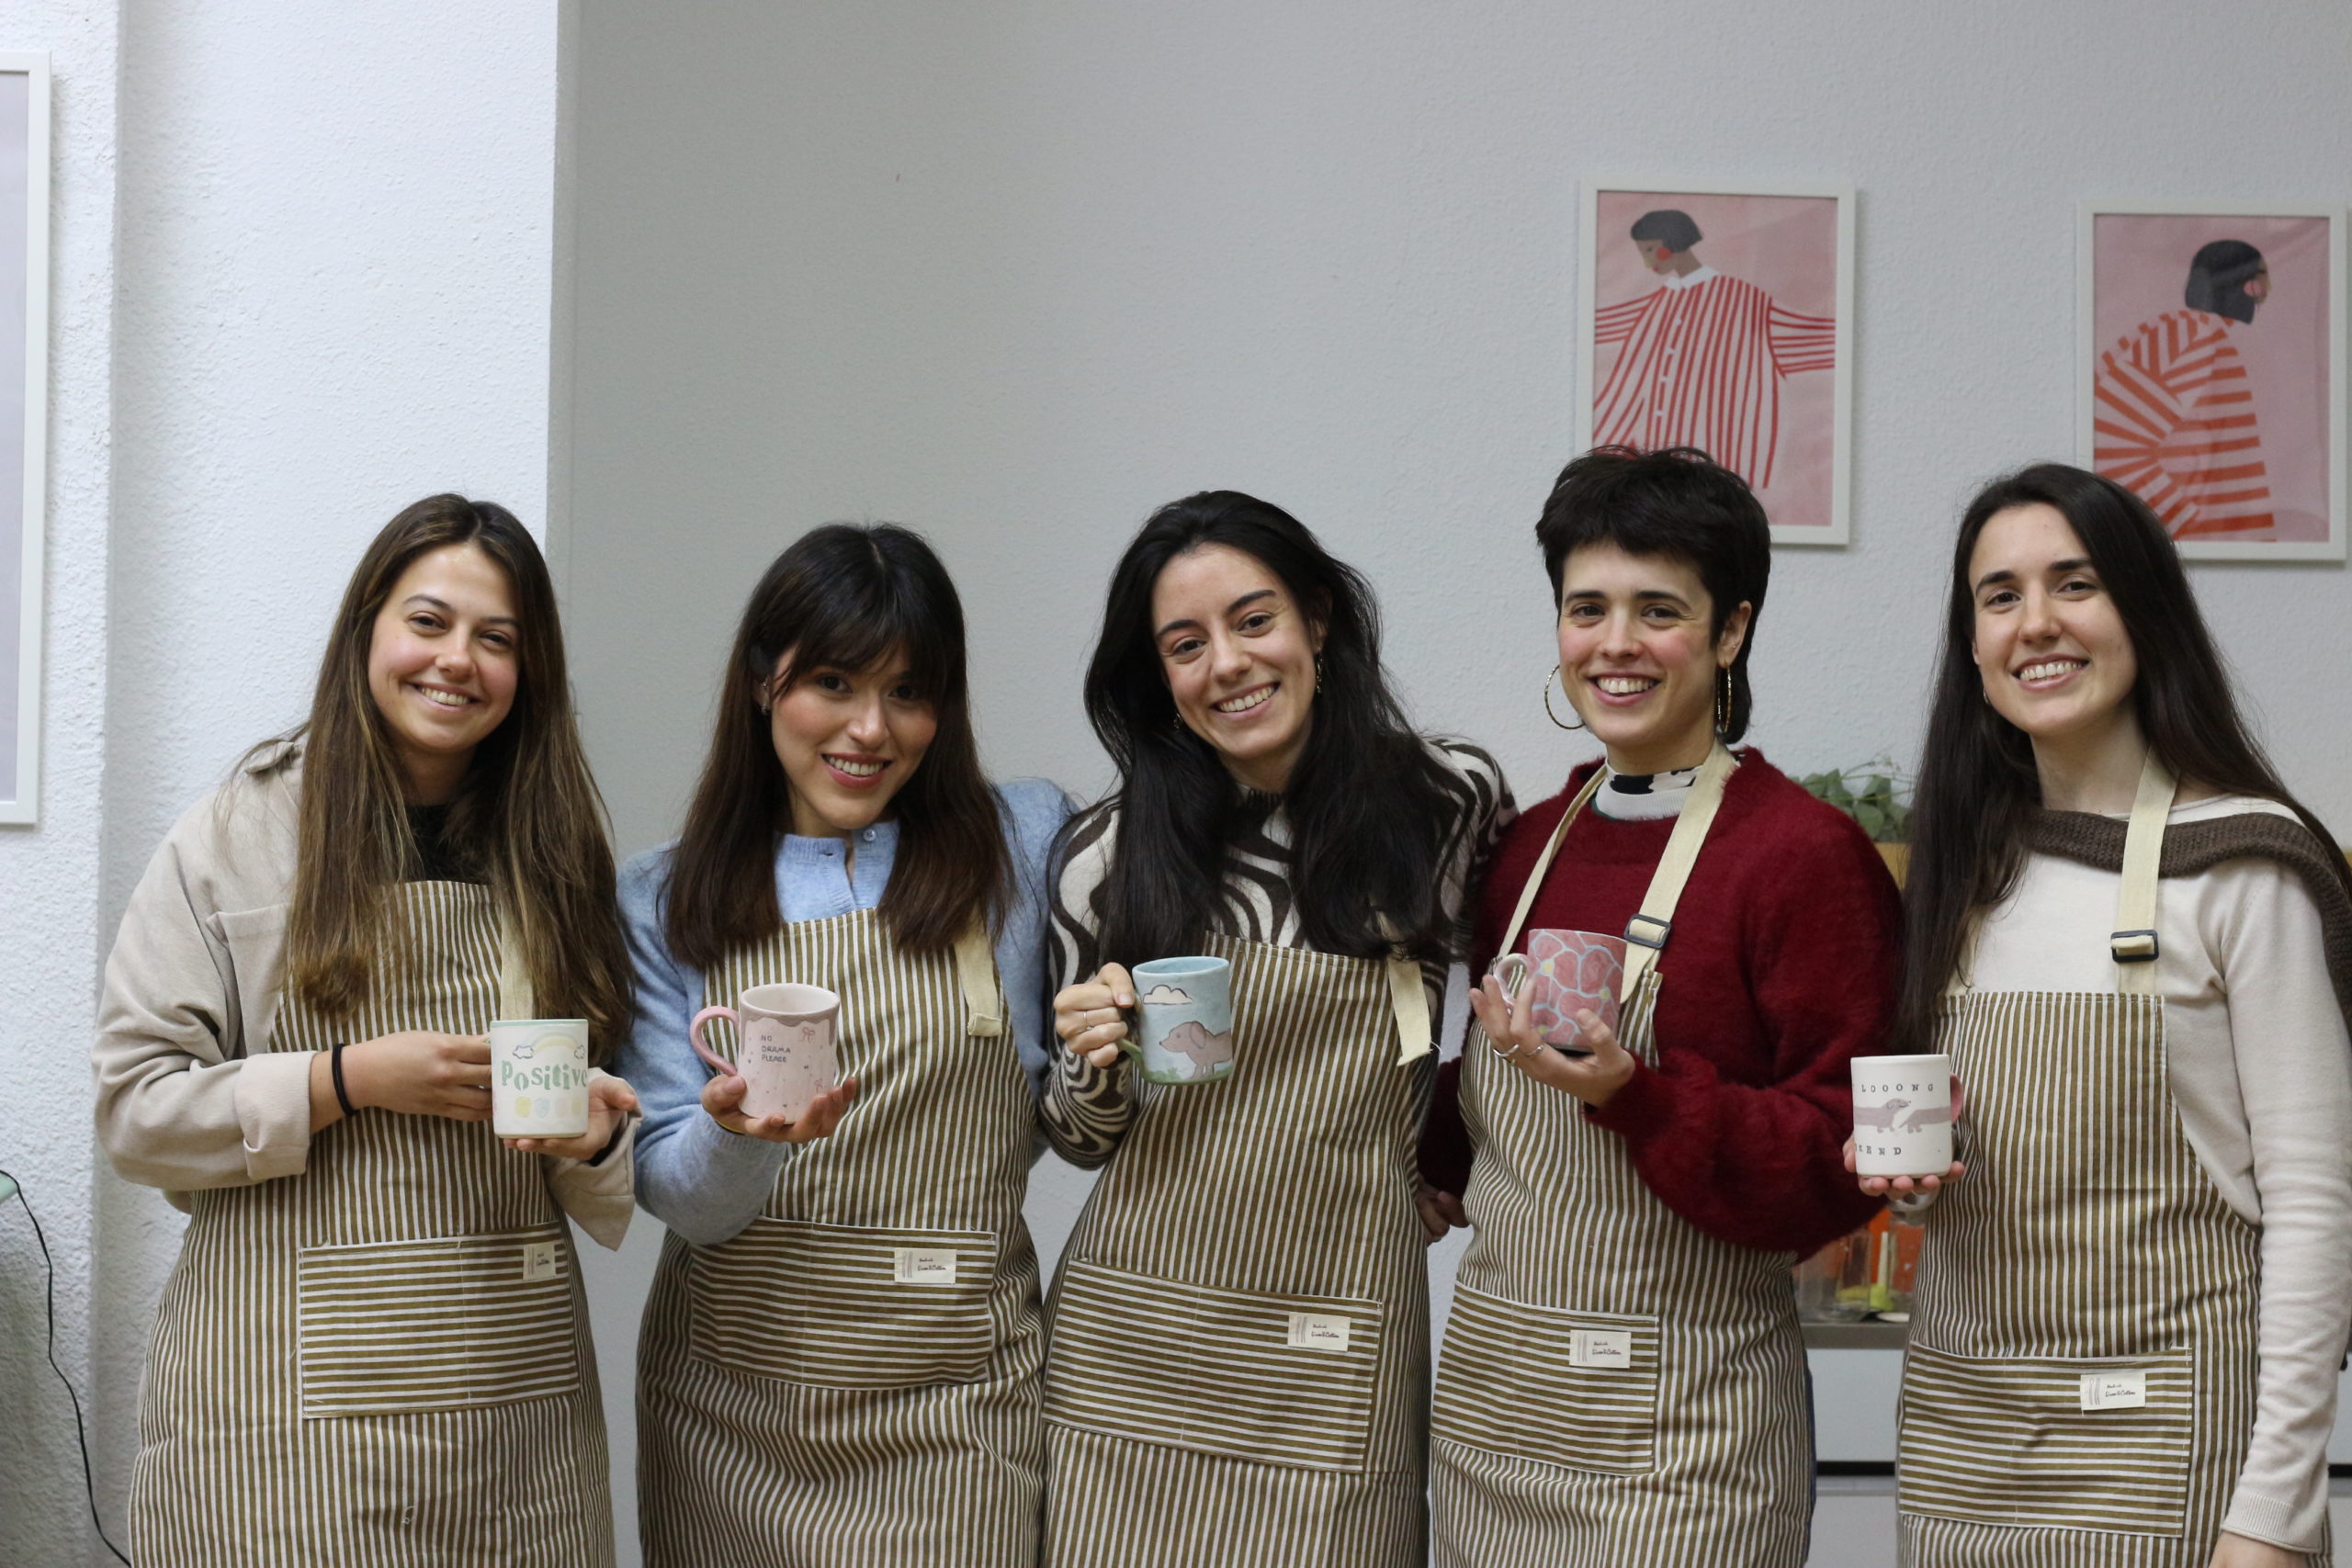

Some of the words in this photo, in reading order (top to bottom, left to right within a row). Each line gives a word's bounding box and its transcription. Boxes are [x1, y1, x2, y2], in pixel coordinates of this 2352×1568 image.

[761, 1045, 791, 1054] DRAMA
[761, 1054, 787, 1064] PLEASE
[501, 1060, 588, 1091] Positive
